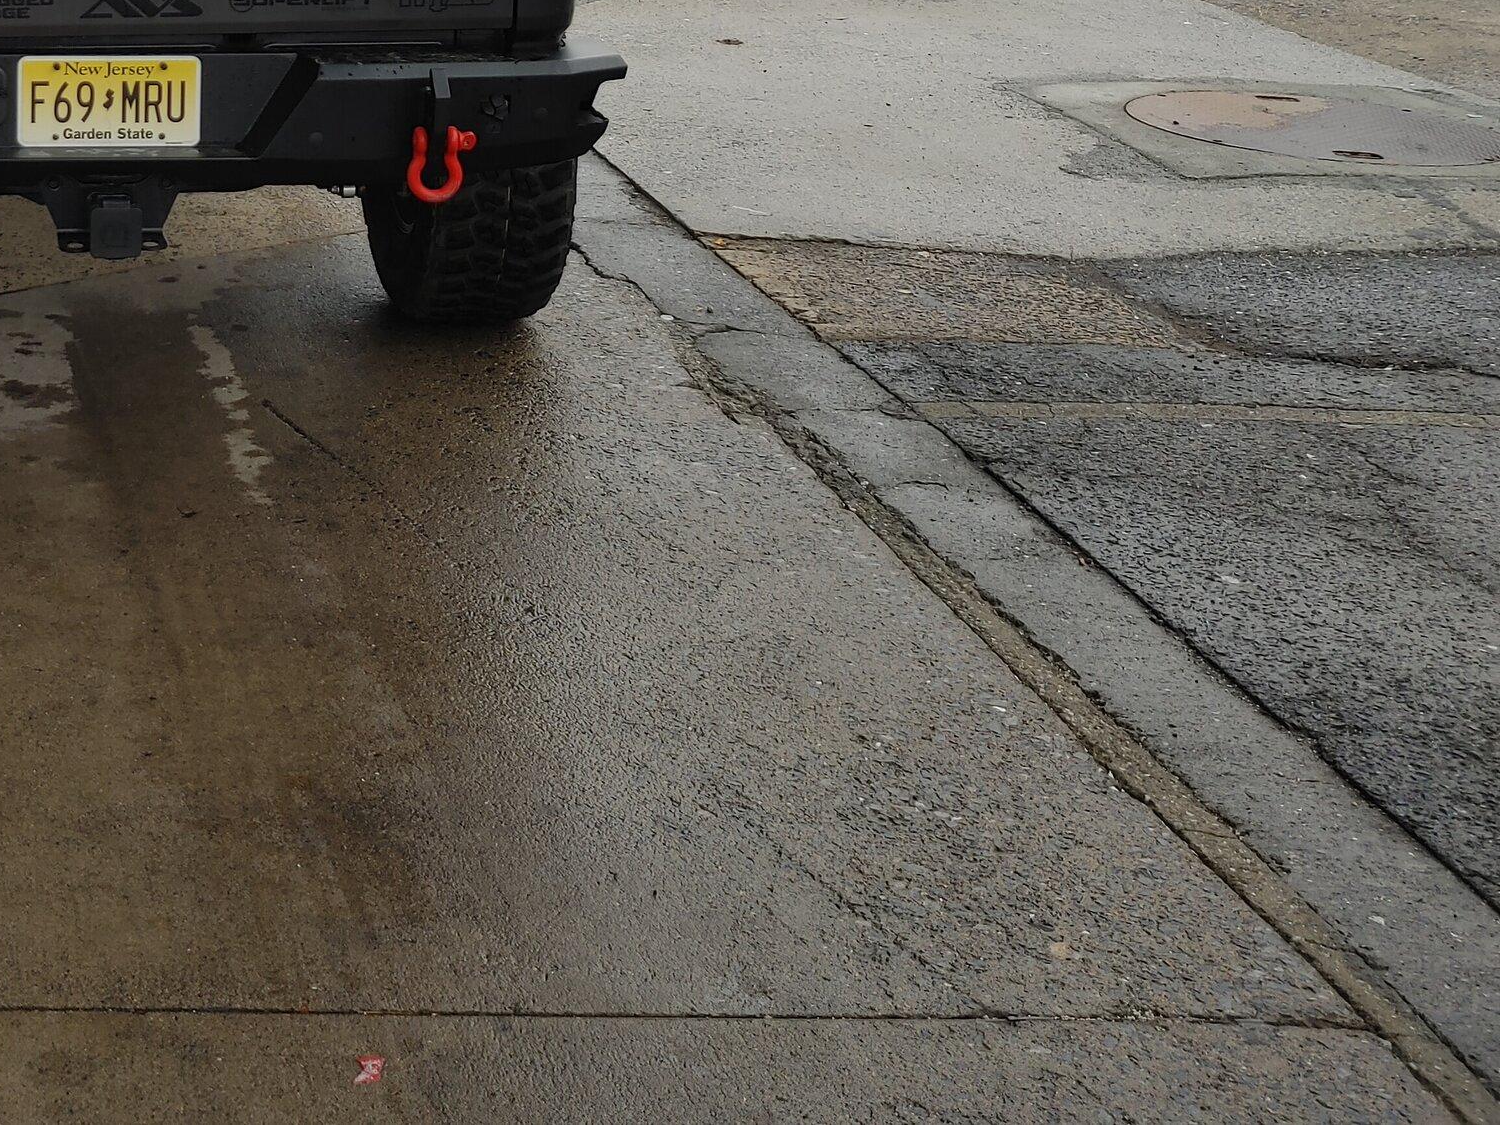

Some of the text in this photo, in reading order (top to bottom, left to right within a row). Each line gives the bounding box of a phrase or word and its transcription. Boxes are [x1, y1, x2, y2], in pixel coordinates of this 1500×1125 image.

[63, 61, 155, 78] New Jersey
[31, 80, 186, 124] F69 MRU
[62, 127, 154, 140] Garden State
